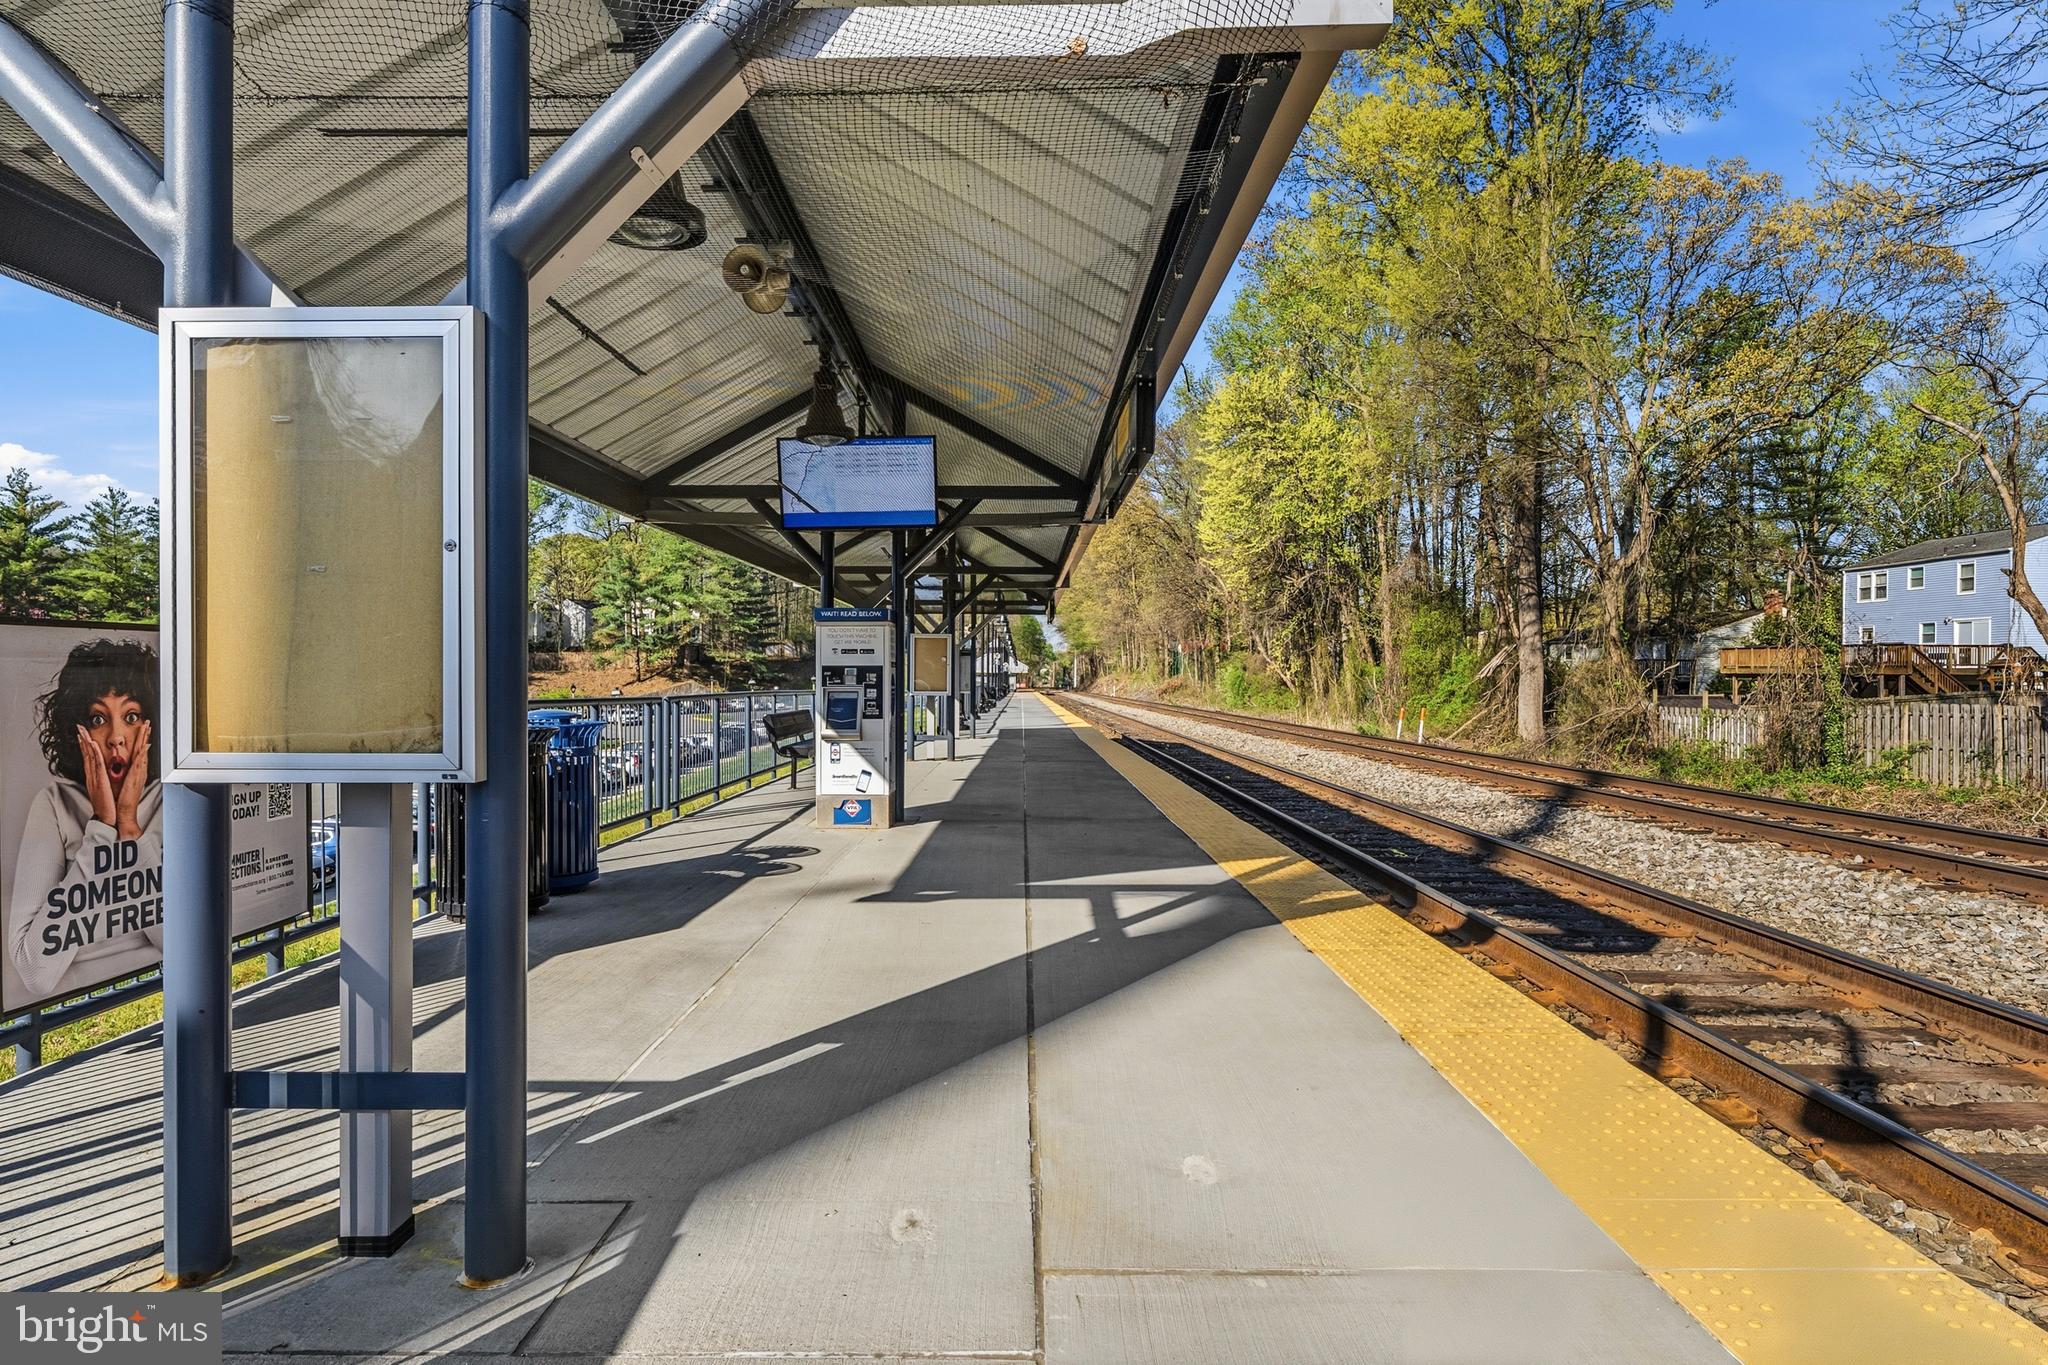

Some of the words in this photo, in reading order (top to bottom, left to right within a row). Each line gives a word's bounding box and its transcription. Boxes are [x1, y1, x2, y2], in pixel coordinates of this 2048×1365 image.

[232, 805, 260, 820] ODAY!
[248, 791, 262, 803] UP
[94, 839, 138, 875] DID
[47, 866, 163, 920] SOMEON
[42, 912, 100, 956] SAY
[107, 896, 163, 939] FREE
